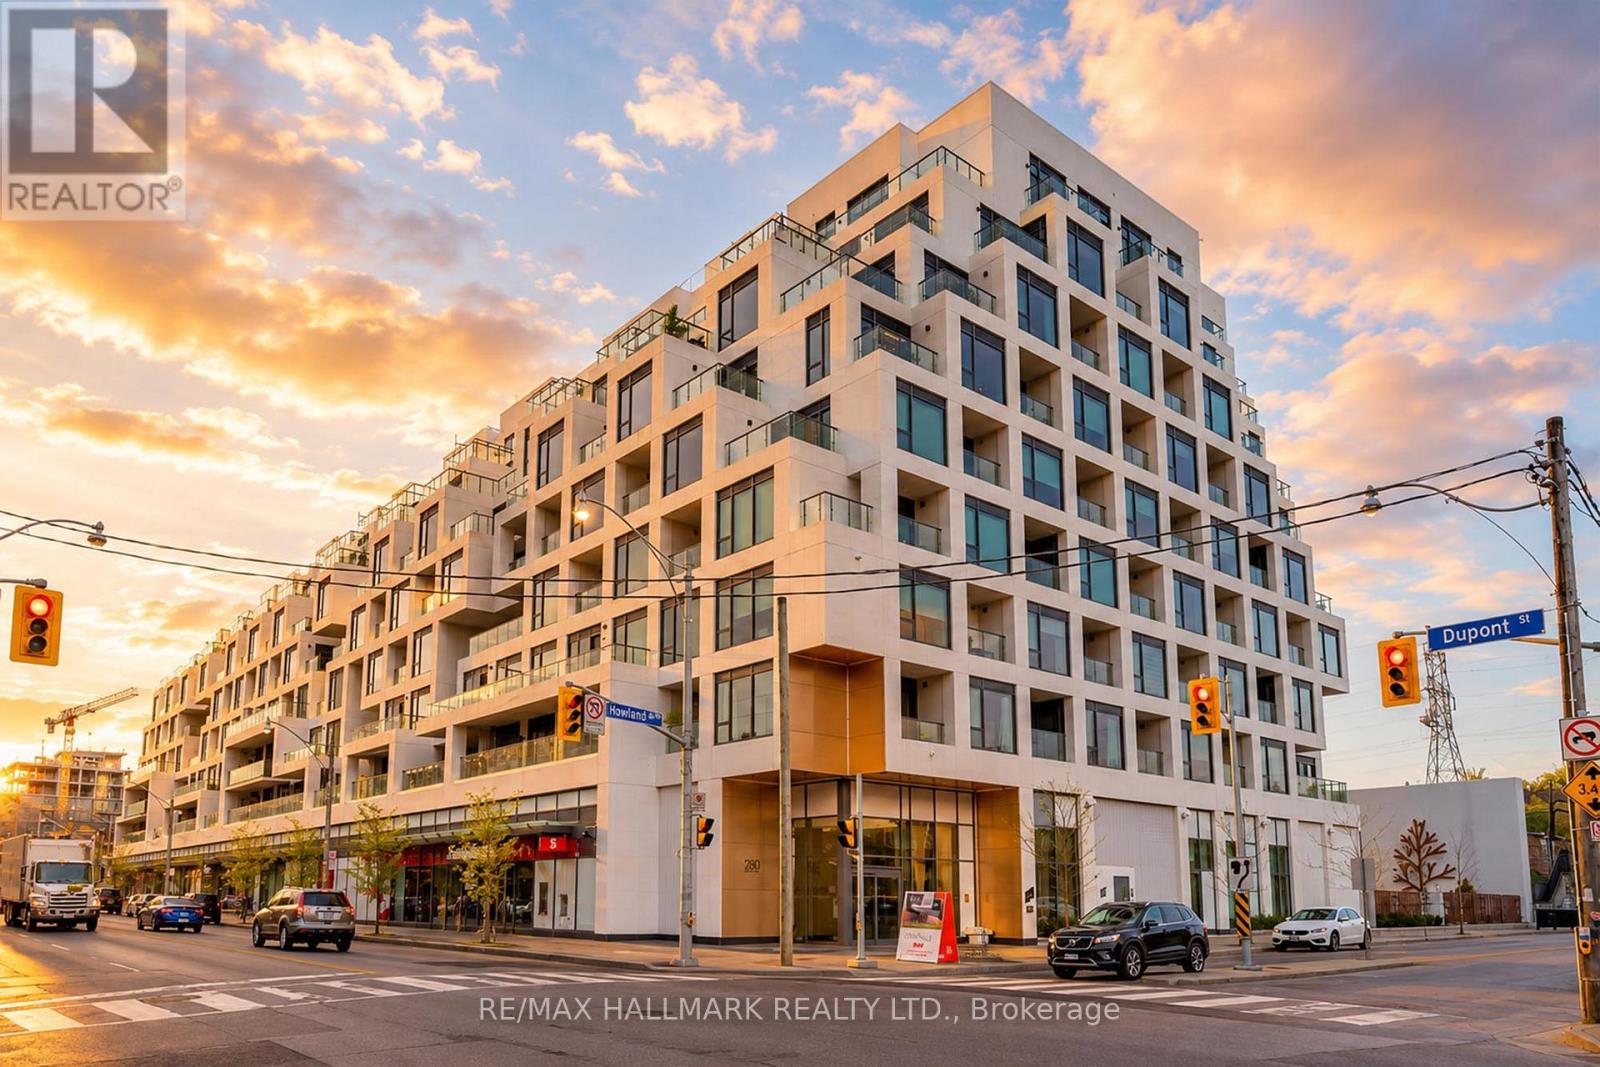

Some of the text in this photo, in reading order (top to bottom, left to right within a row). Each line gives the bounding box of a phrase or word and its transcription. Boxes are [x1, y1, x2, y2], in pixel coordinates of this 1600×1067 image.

[1443, 613, 1530, 644] Dupont St
[609, 704, 647, 722] Howland
[744, 859, 761, 872] 280
